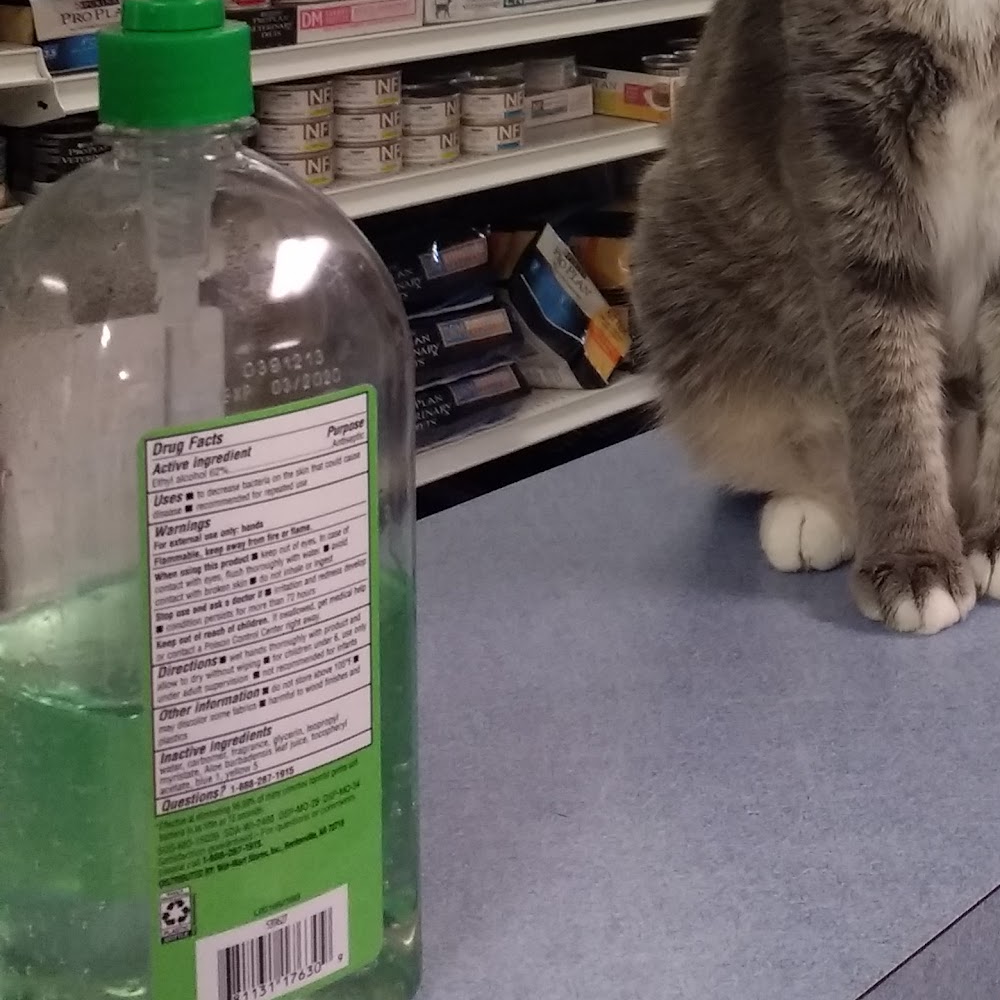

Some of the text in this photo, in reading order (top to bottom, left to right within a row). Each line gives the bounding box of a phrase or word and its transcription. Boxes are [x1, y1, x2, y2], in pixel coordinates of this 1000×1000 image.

[60, 8, 122, 26] PRO PLA
[302, 11, 323, 28] DM
[376, 78, 398, 95] NF
[308, 88, 332, 106] NF
[505, 92, 524, 109] NF
[445, 102, 454, 117] N
[380, 112, 400, 129] NF
[304, 123, 329, 140] NF
[498, 125, 521, 140] NF
[379, 145, 400, 162] NF
[305, 158, 330, 175] NF
[271, 367, 341, 395] 03/2020
[327, 419, 364, 437] Purpose
[153, 433, 224, 456] Drug Facts
[152, 447, 252, 475] Active ingredient
[154, 493, 184, 507] Uses
[283, 470, 294, 479] the
[155, 519, 211, 537] Warnings
[154, 541, 167, 550] For
[169, 535, 202, 547] external
[204, 532, 217, 540] use
[226, 542, 245, 552] away
[267, 531, 280, 540] fire
[204, 562, 218, 571] this
[204, 627, 225, 638] reach
[158, 656, 217, 678] Directions
[159, 689, 259, 721] Other information
[160, 726, 272, 763] Inactive ingredients
[162, 786, 226, 812] Questions?
[283, 962, 322, 986] 17630
